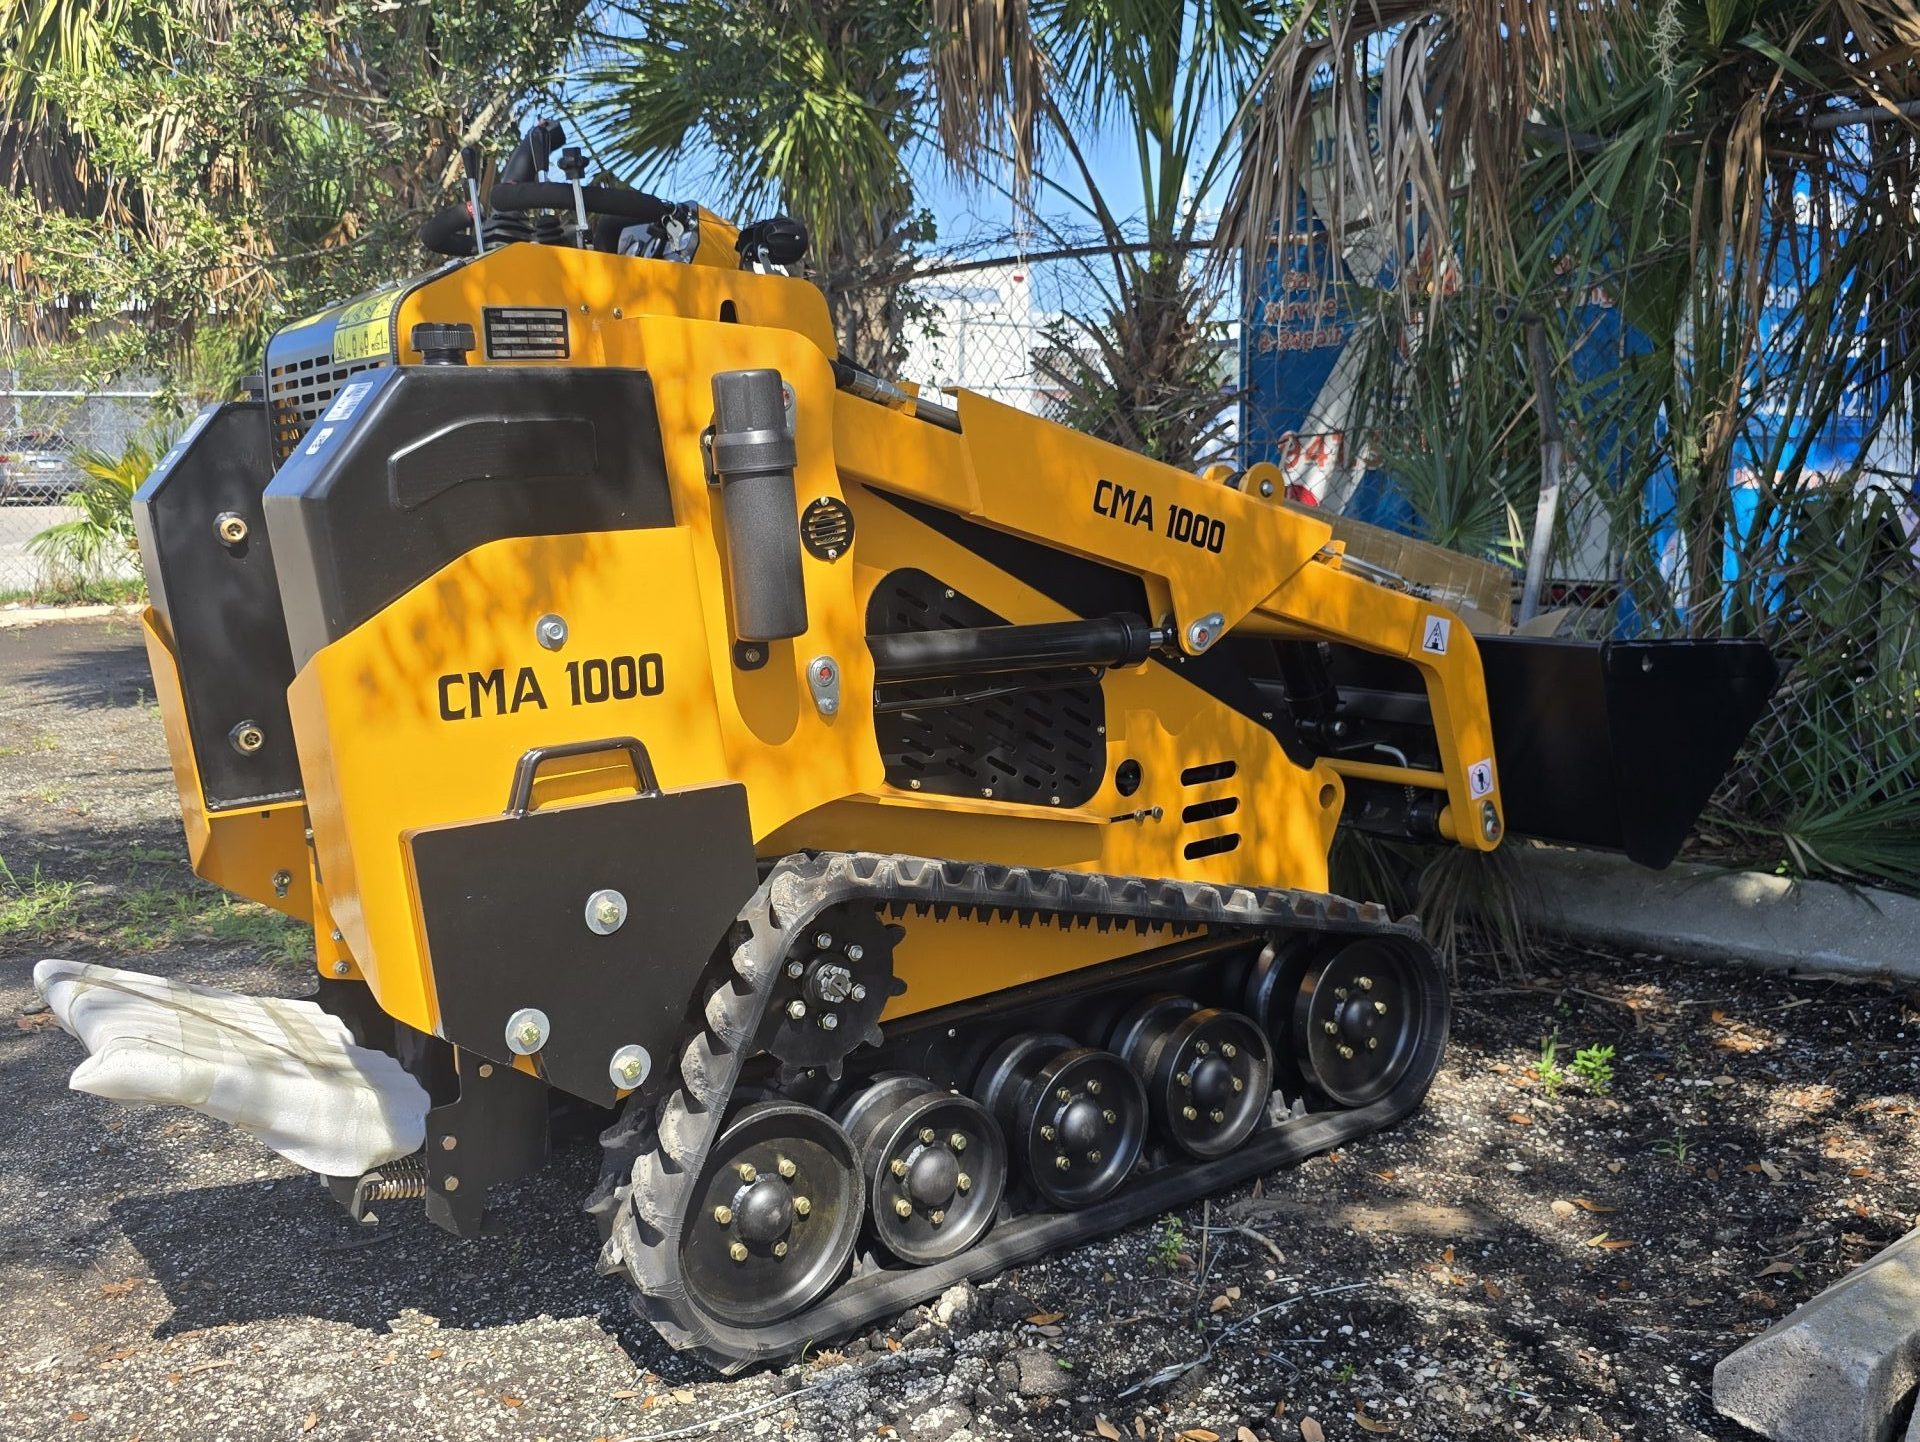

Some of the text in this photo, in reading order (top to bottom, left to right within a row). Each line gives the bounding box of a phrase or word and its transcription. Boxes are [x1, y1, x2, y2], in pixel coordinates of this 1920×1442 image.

[1093, 479, 1226, 554] CMA 1000
[438, 652, 665, 722] CMA 1000
